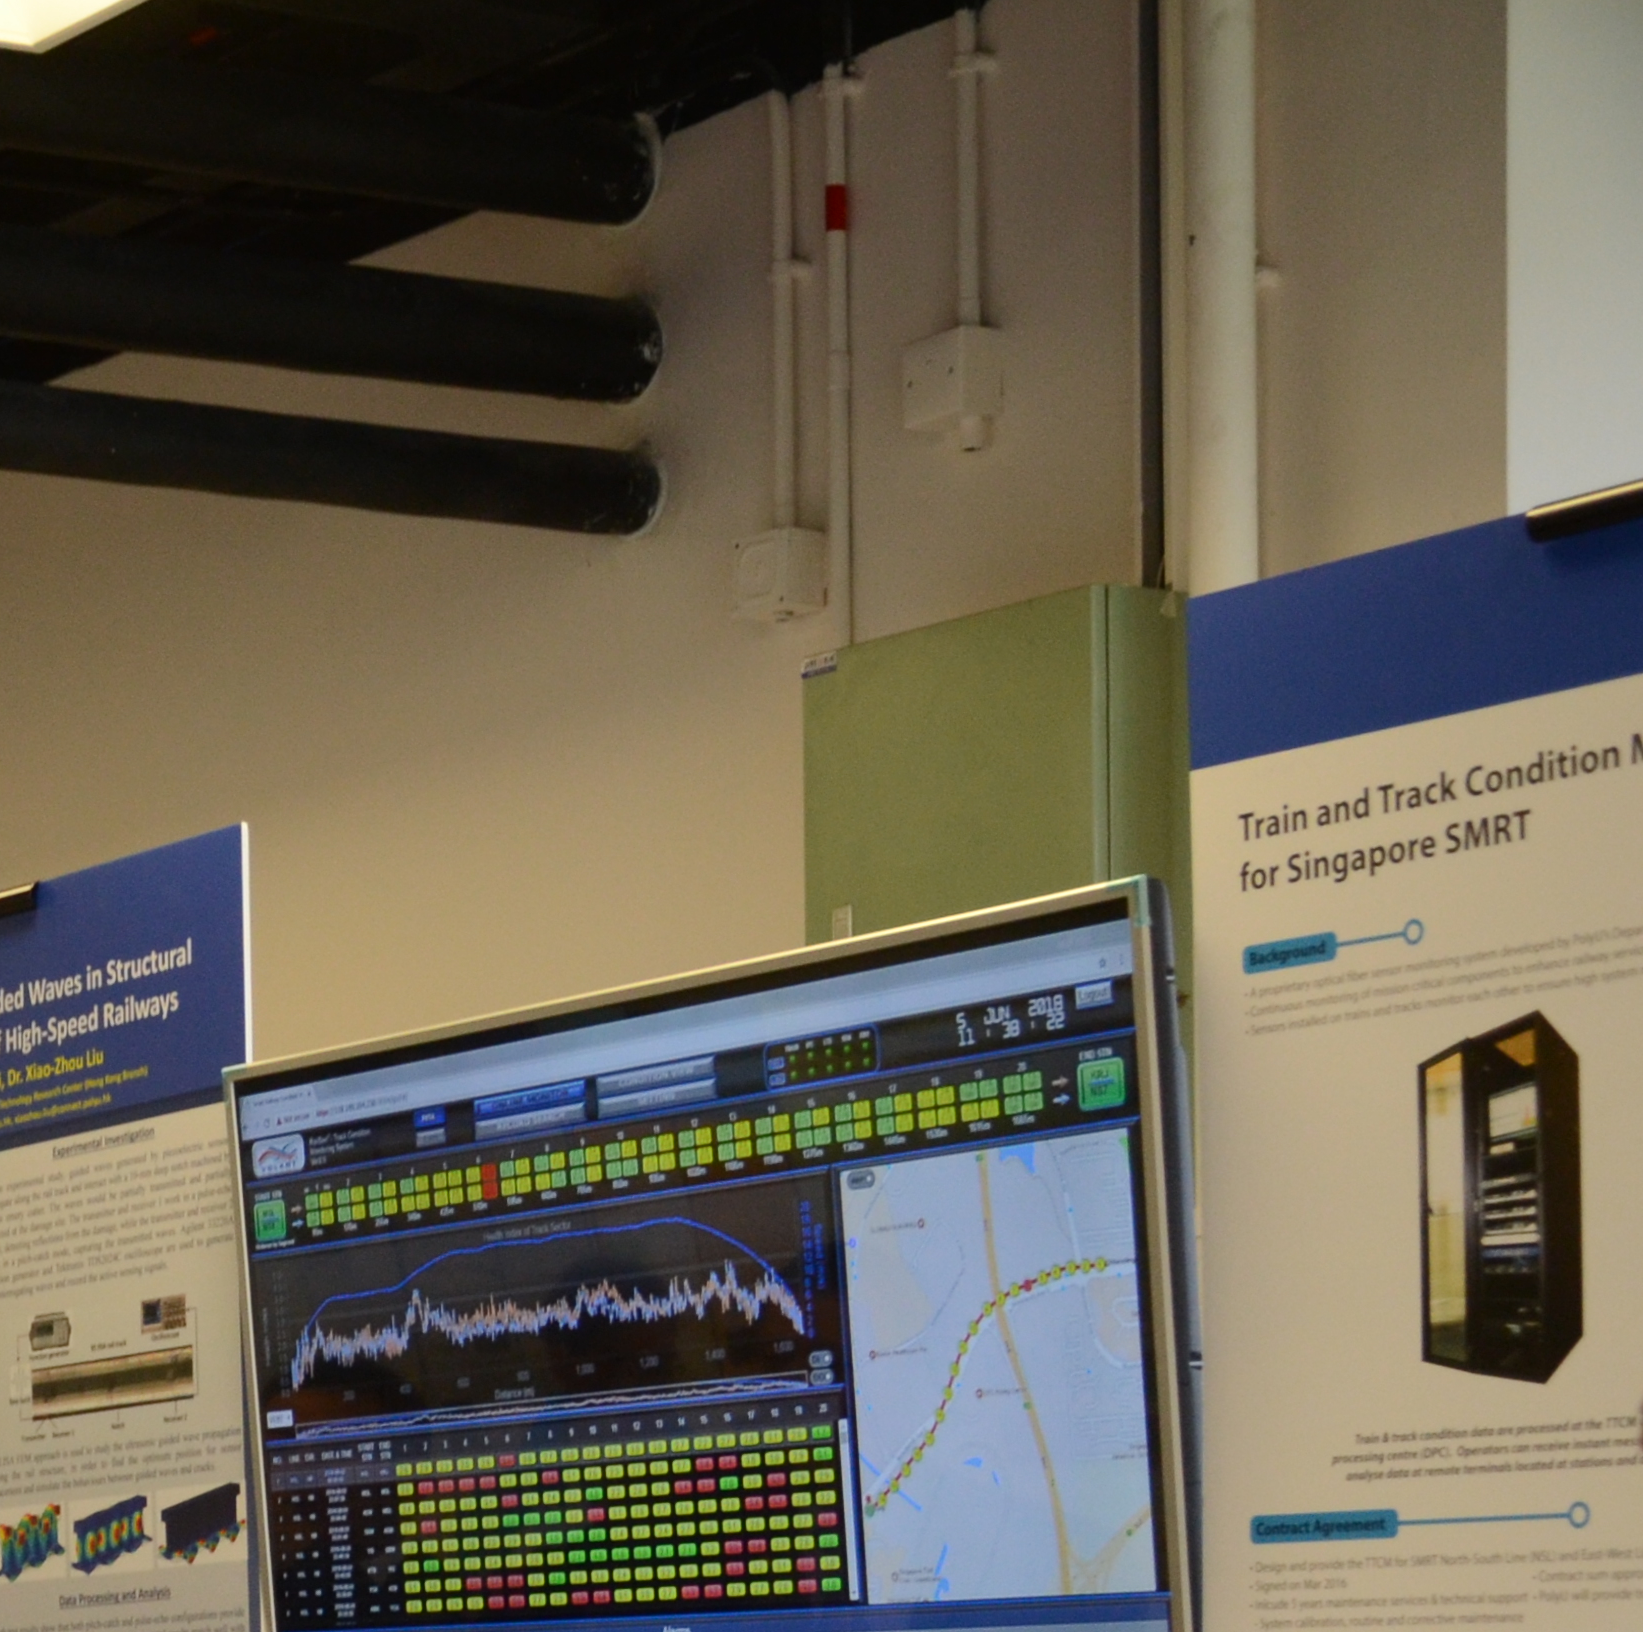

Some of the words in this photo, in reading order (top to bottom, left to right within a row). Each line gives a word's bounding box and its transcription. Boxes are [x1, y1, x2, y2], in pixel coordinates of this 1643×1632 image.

[1239, 805, 1308, 842] Train
[1317, 788, 1370, 827] and
[1378, 772, 1457, 813] Track
[1465, 745, 1621, 797] Condition
[1240, 861, 1279, 892] for
[1288, 833, 1437, 883] Singapore
[1446, 809, 1531, 854] SMRT
[1248, 940, 1327, 969] Background
[28, 974, 82, 1005] Waves
[86, 965, 102, 990] in
[106, 937, 192, 986] Structural
[984, 1005, 1011, 1025] JUN
[1028, 994, 1063, 1017] 2018
[1077, 986, 1109, 1003] Logout
[6, 1004, 98, 1055] High-Speed
[103, 991, 179, 1028] Railways
[958, 1028, 975, 1047] 11
[1046, 1011, 1065, 1031] 22
[8, 1068, 23, 1087] Dr.
[26, 1055, 84, 1082] Xiao-Zhou
[86, 1048, 104, 1068] Liu
[52, 1134, 103, 1159] Experimental
[105, 1127, 155, 1147] Investigation
[1356, 1433, 1379, 1445] Train
[1382, 1432, 1390, 1443] &
[1392, 1430, 1417, 1442] track
[1419, 1428, 1468, 1441] condition
[1471, 1426, 1494, 1437] data
[1497, 1427, 1514, 1436] are
[1517, 1421, 1569, 1437] processed
[1571, 1422, 1583, 1432] at
[1585, 1419, 1602, 1431] the
[1606, 1417, 1637, 1429] TTCM
[1332, 1452, 1384, 1466] processing
[1387, 1450, 1418, 1461] centre
[1457, 1444, 1509, 1458] Operators
[1512, 1444, 1530, 1453] can
[1533, 1441, 1570, 1452] receive
[1573, 1438, 1611, 1449] instant
[1346, 1469, 1384, 1482] analyse
[1387, 1467, 1410, 1479] data
[1413, 1467, 1422, 1477] at
[1425, 1466, 1461, 1477] remote
[1464, 1463, 1512, 1475] terminals
[1515, 1461, 1553, 1472] located
[1556, 1460, 1566, 1469] at
[1570, 1457, 1612, 1469] stations
[1617, 1455, 1636, 1466] and
[1256, 1520, 1312, 1536] Contract
[1314, 1517, 1386, 1537] Agreement
[59, 1593, 77, 1607] Data
[79, 1590, 119, 1606] Processing
[122, 1589, 136, 1601] and
[138, 1586, 171, 1600] Analysis
